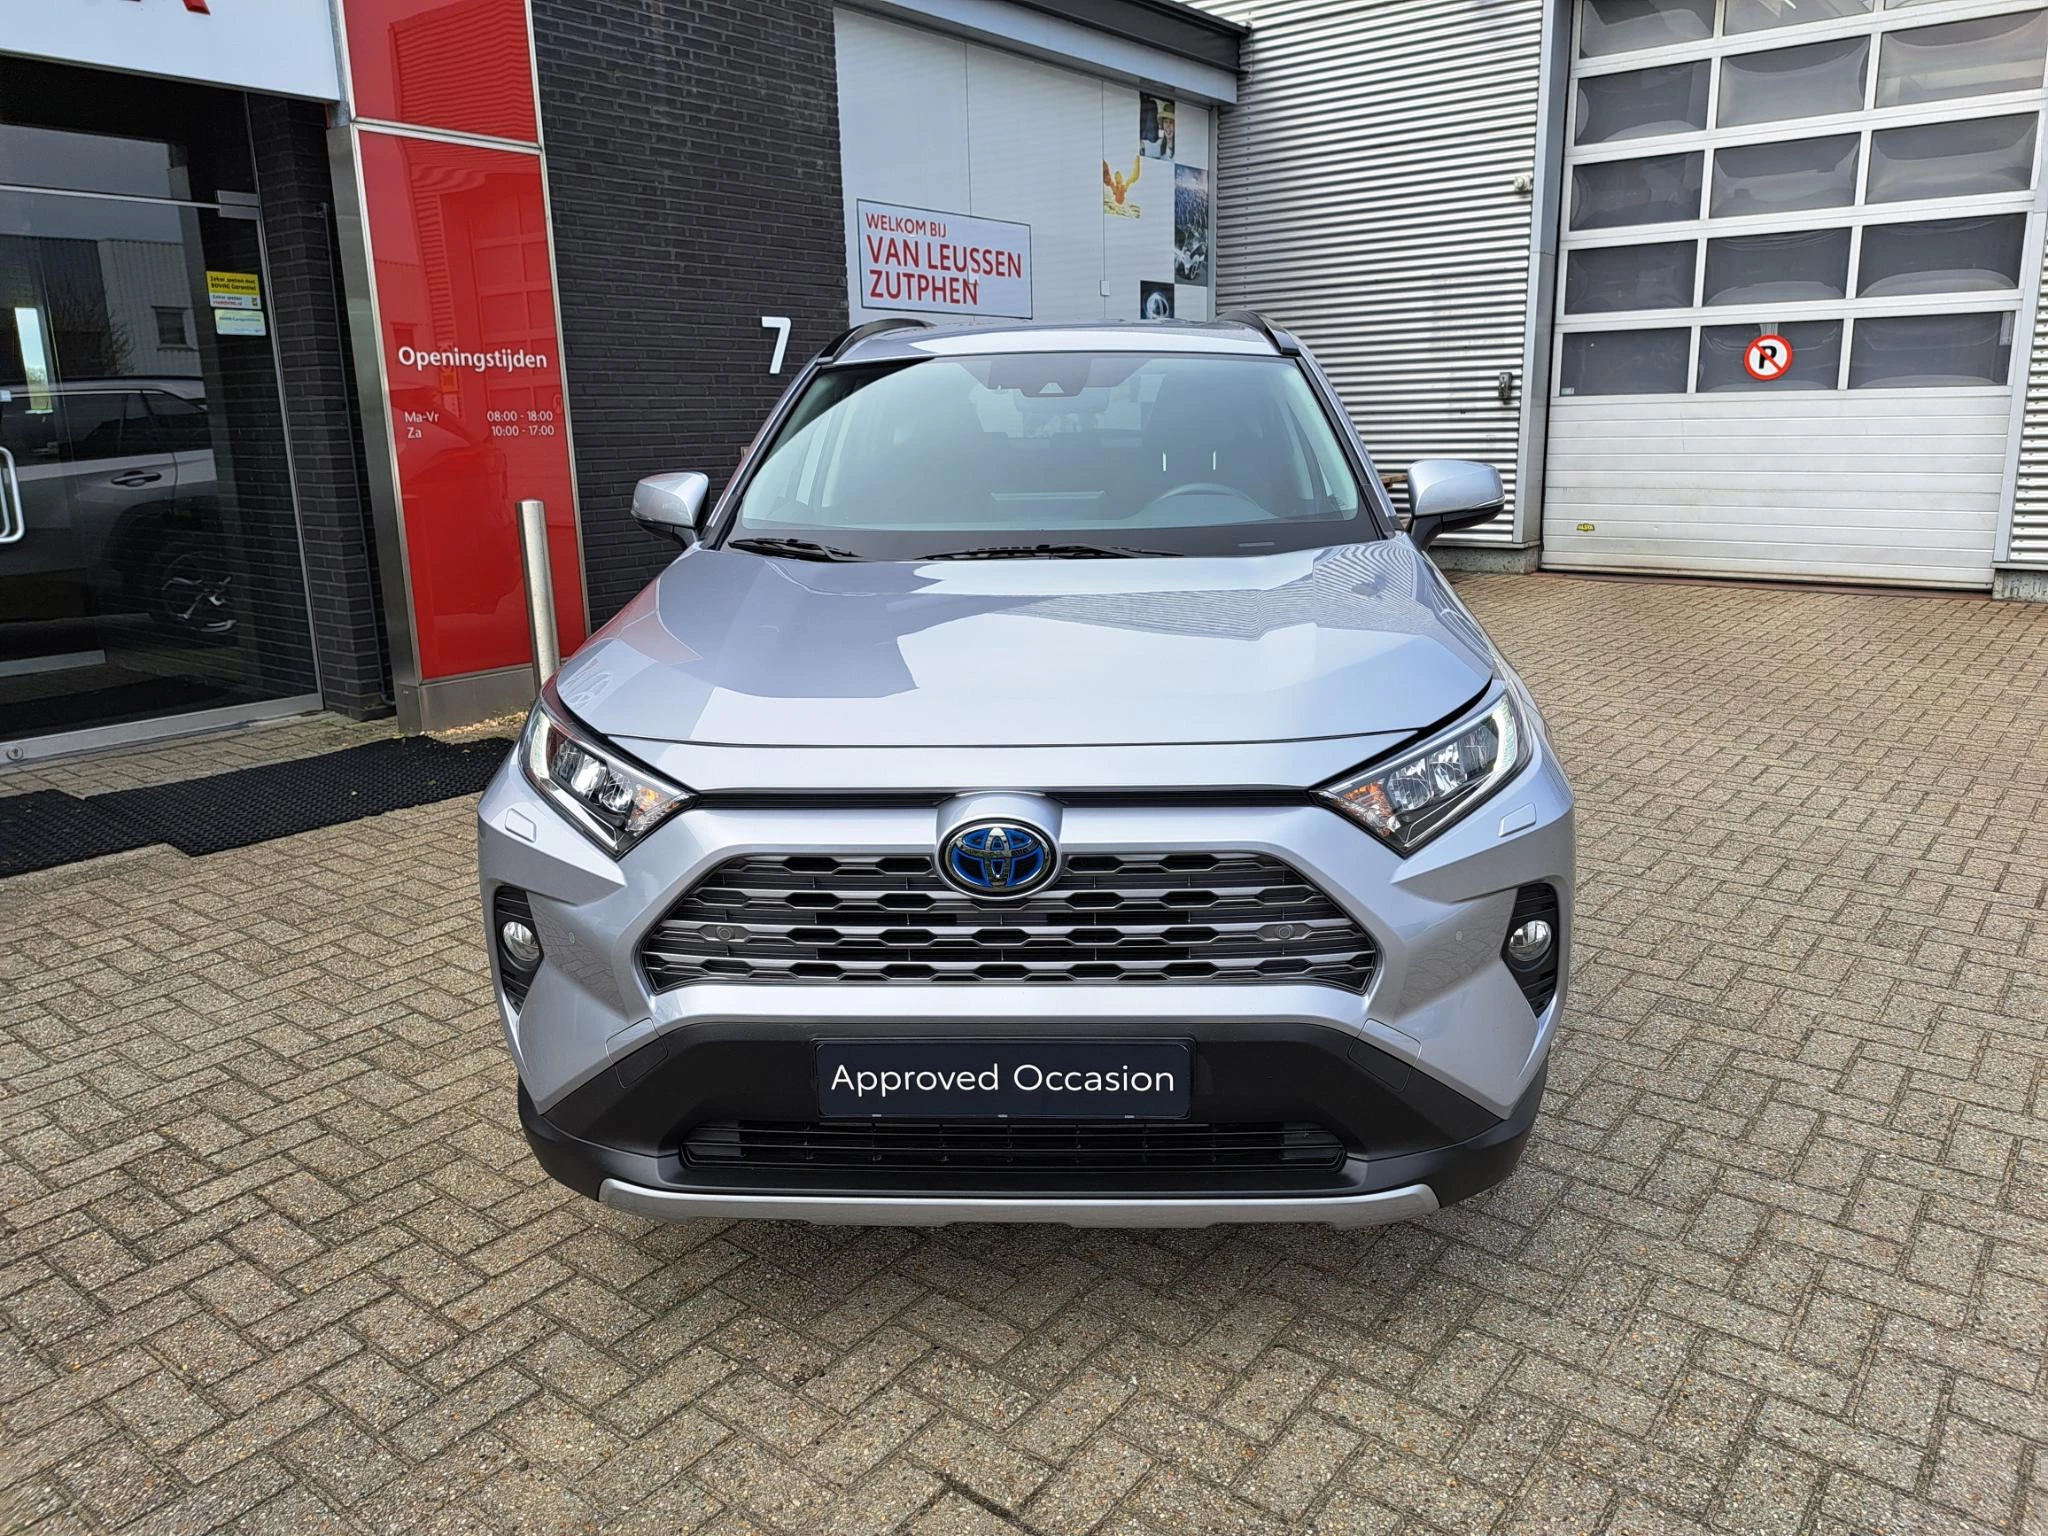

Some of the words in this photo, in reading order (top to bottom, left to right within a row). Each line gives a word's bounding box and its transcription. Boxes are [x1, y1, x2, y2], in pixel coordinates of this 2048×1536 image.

[865, 212, 927, 236] WELKOM
[930, 222, 947, 239] BIJ
[866, 234, 920, 269] VAN
[927, 241, 1022, 279] LEUSSEN
[869, 269, 979, 306] ZUTPHEN
[398, 345, 548, 372] Openingstijden
[761, 316, 792, 374] 7
[1758, 345, 1778, 370] P
[404, 410, 440, 423] Ma-Vr
[486, 410, 518, 422] 08:00
[527, 410, 553, 422] 18:00
[407, 426, 422, 439] Za
[491, 425, 519, 437] 10:00
[529, 424, 555, 437] 17:00
[831, 1063, 1000, 1098] Approved
[1013, 1064, 1175, 1092] Occasion
